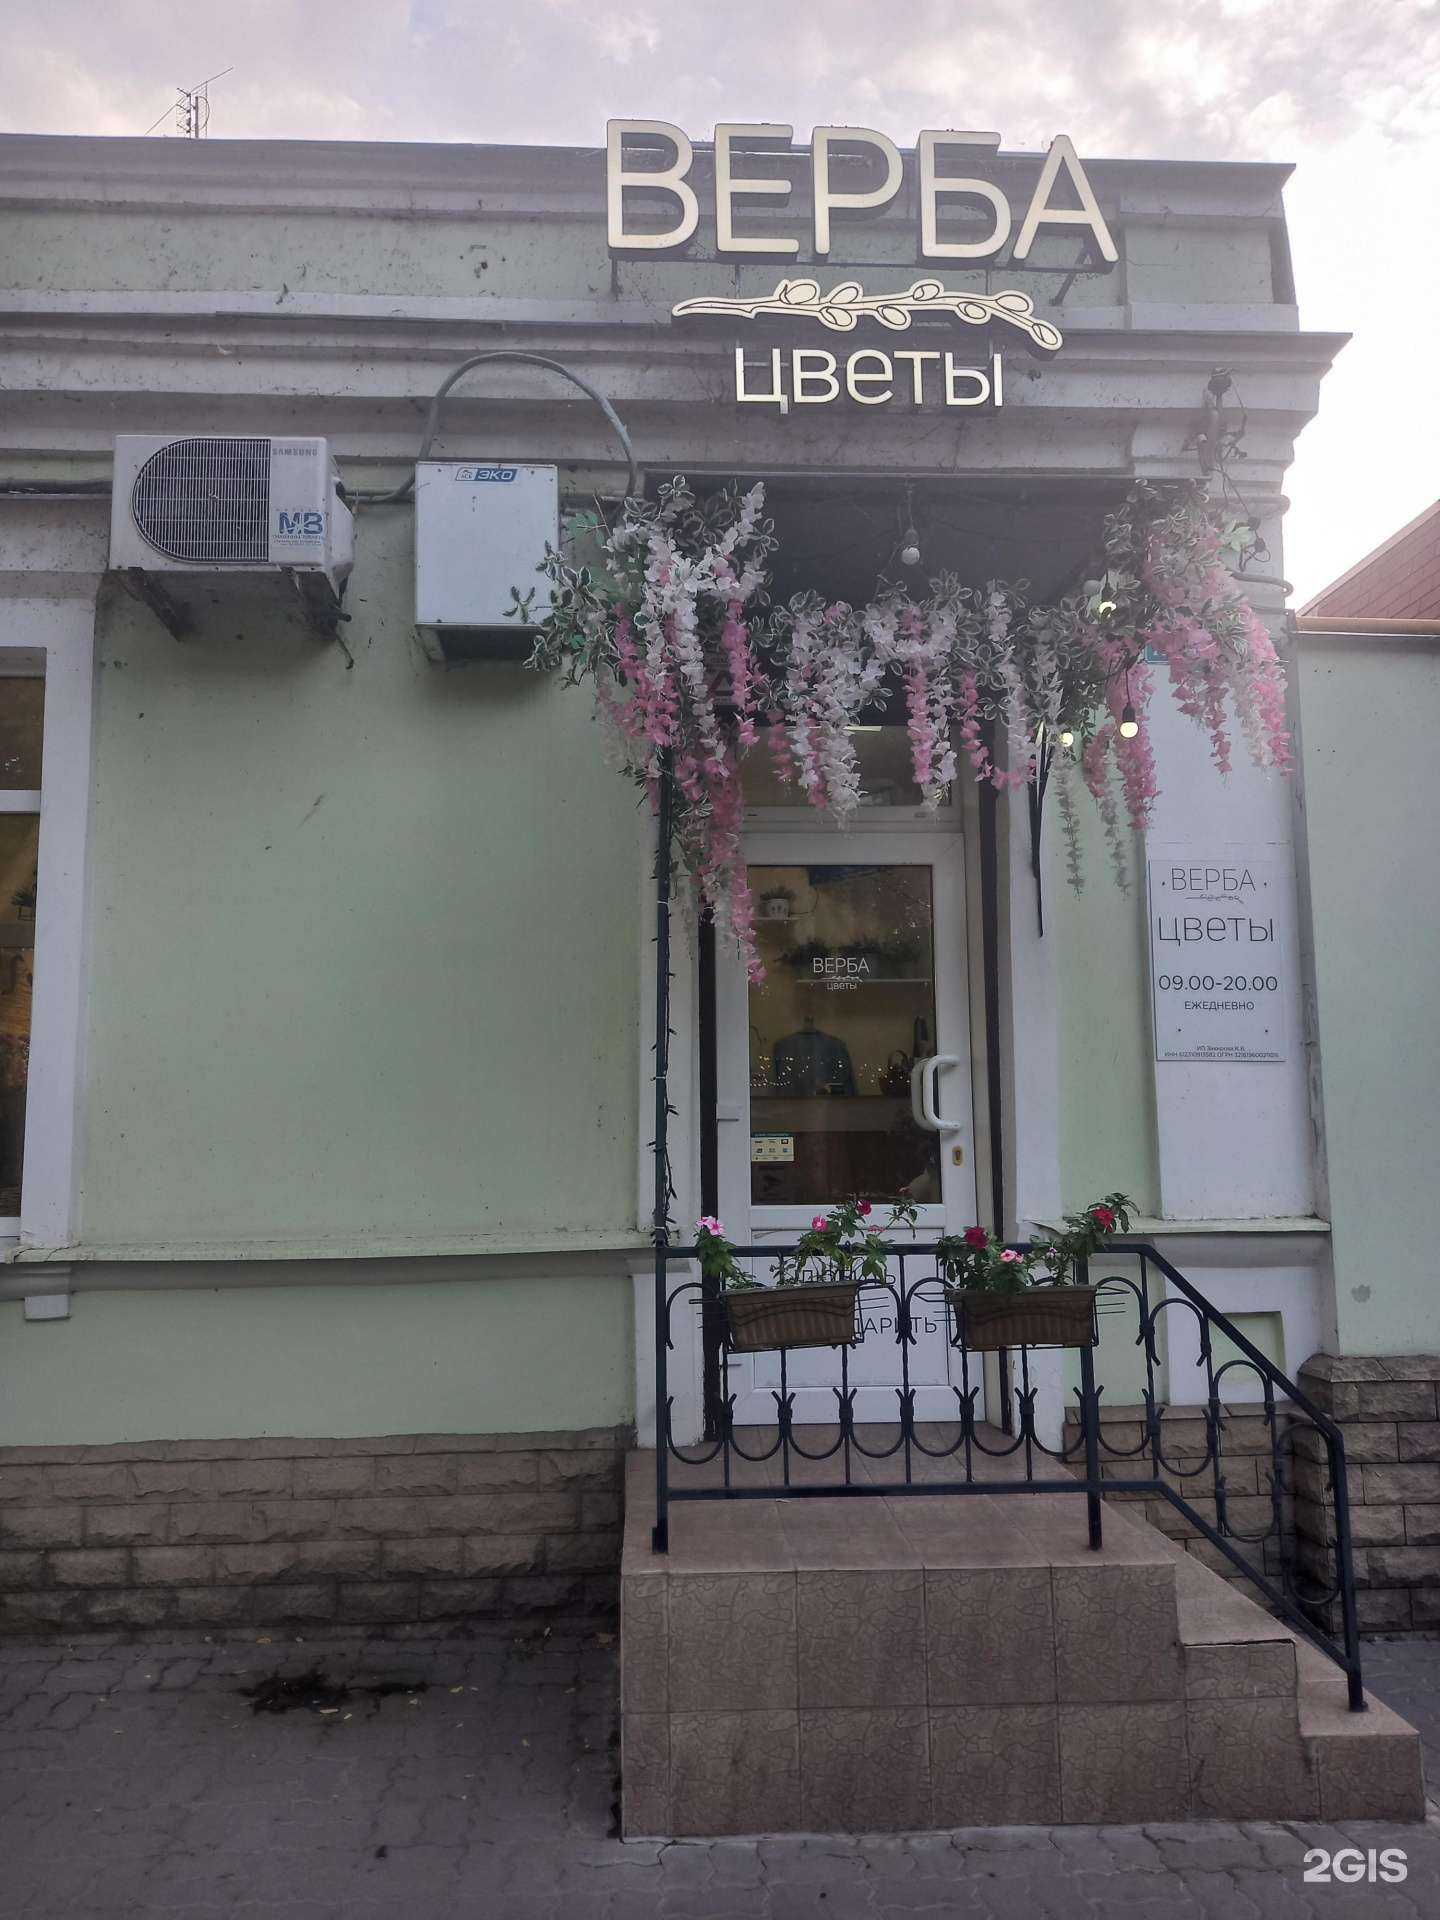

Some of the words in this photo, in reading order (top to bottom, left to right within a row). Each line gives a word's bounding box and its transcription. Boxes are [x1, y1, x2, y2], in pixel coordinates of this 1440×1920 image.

[606, 118, 1119, 263] ВЕРБА
[1170, 867, 1257, 892] ВЕРБА
[812, 956, 870, 974] ВЕРБА
[1158, 974, 1279, 992] 09.00-20.00
[1183, 1000, 1256, 1011] ЕЖЕДНЕВНО
